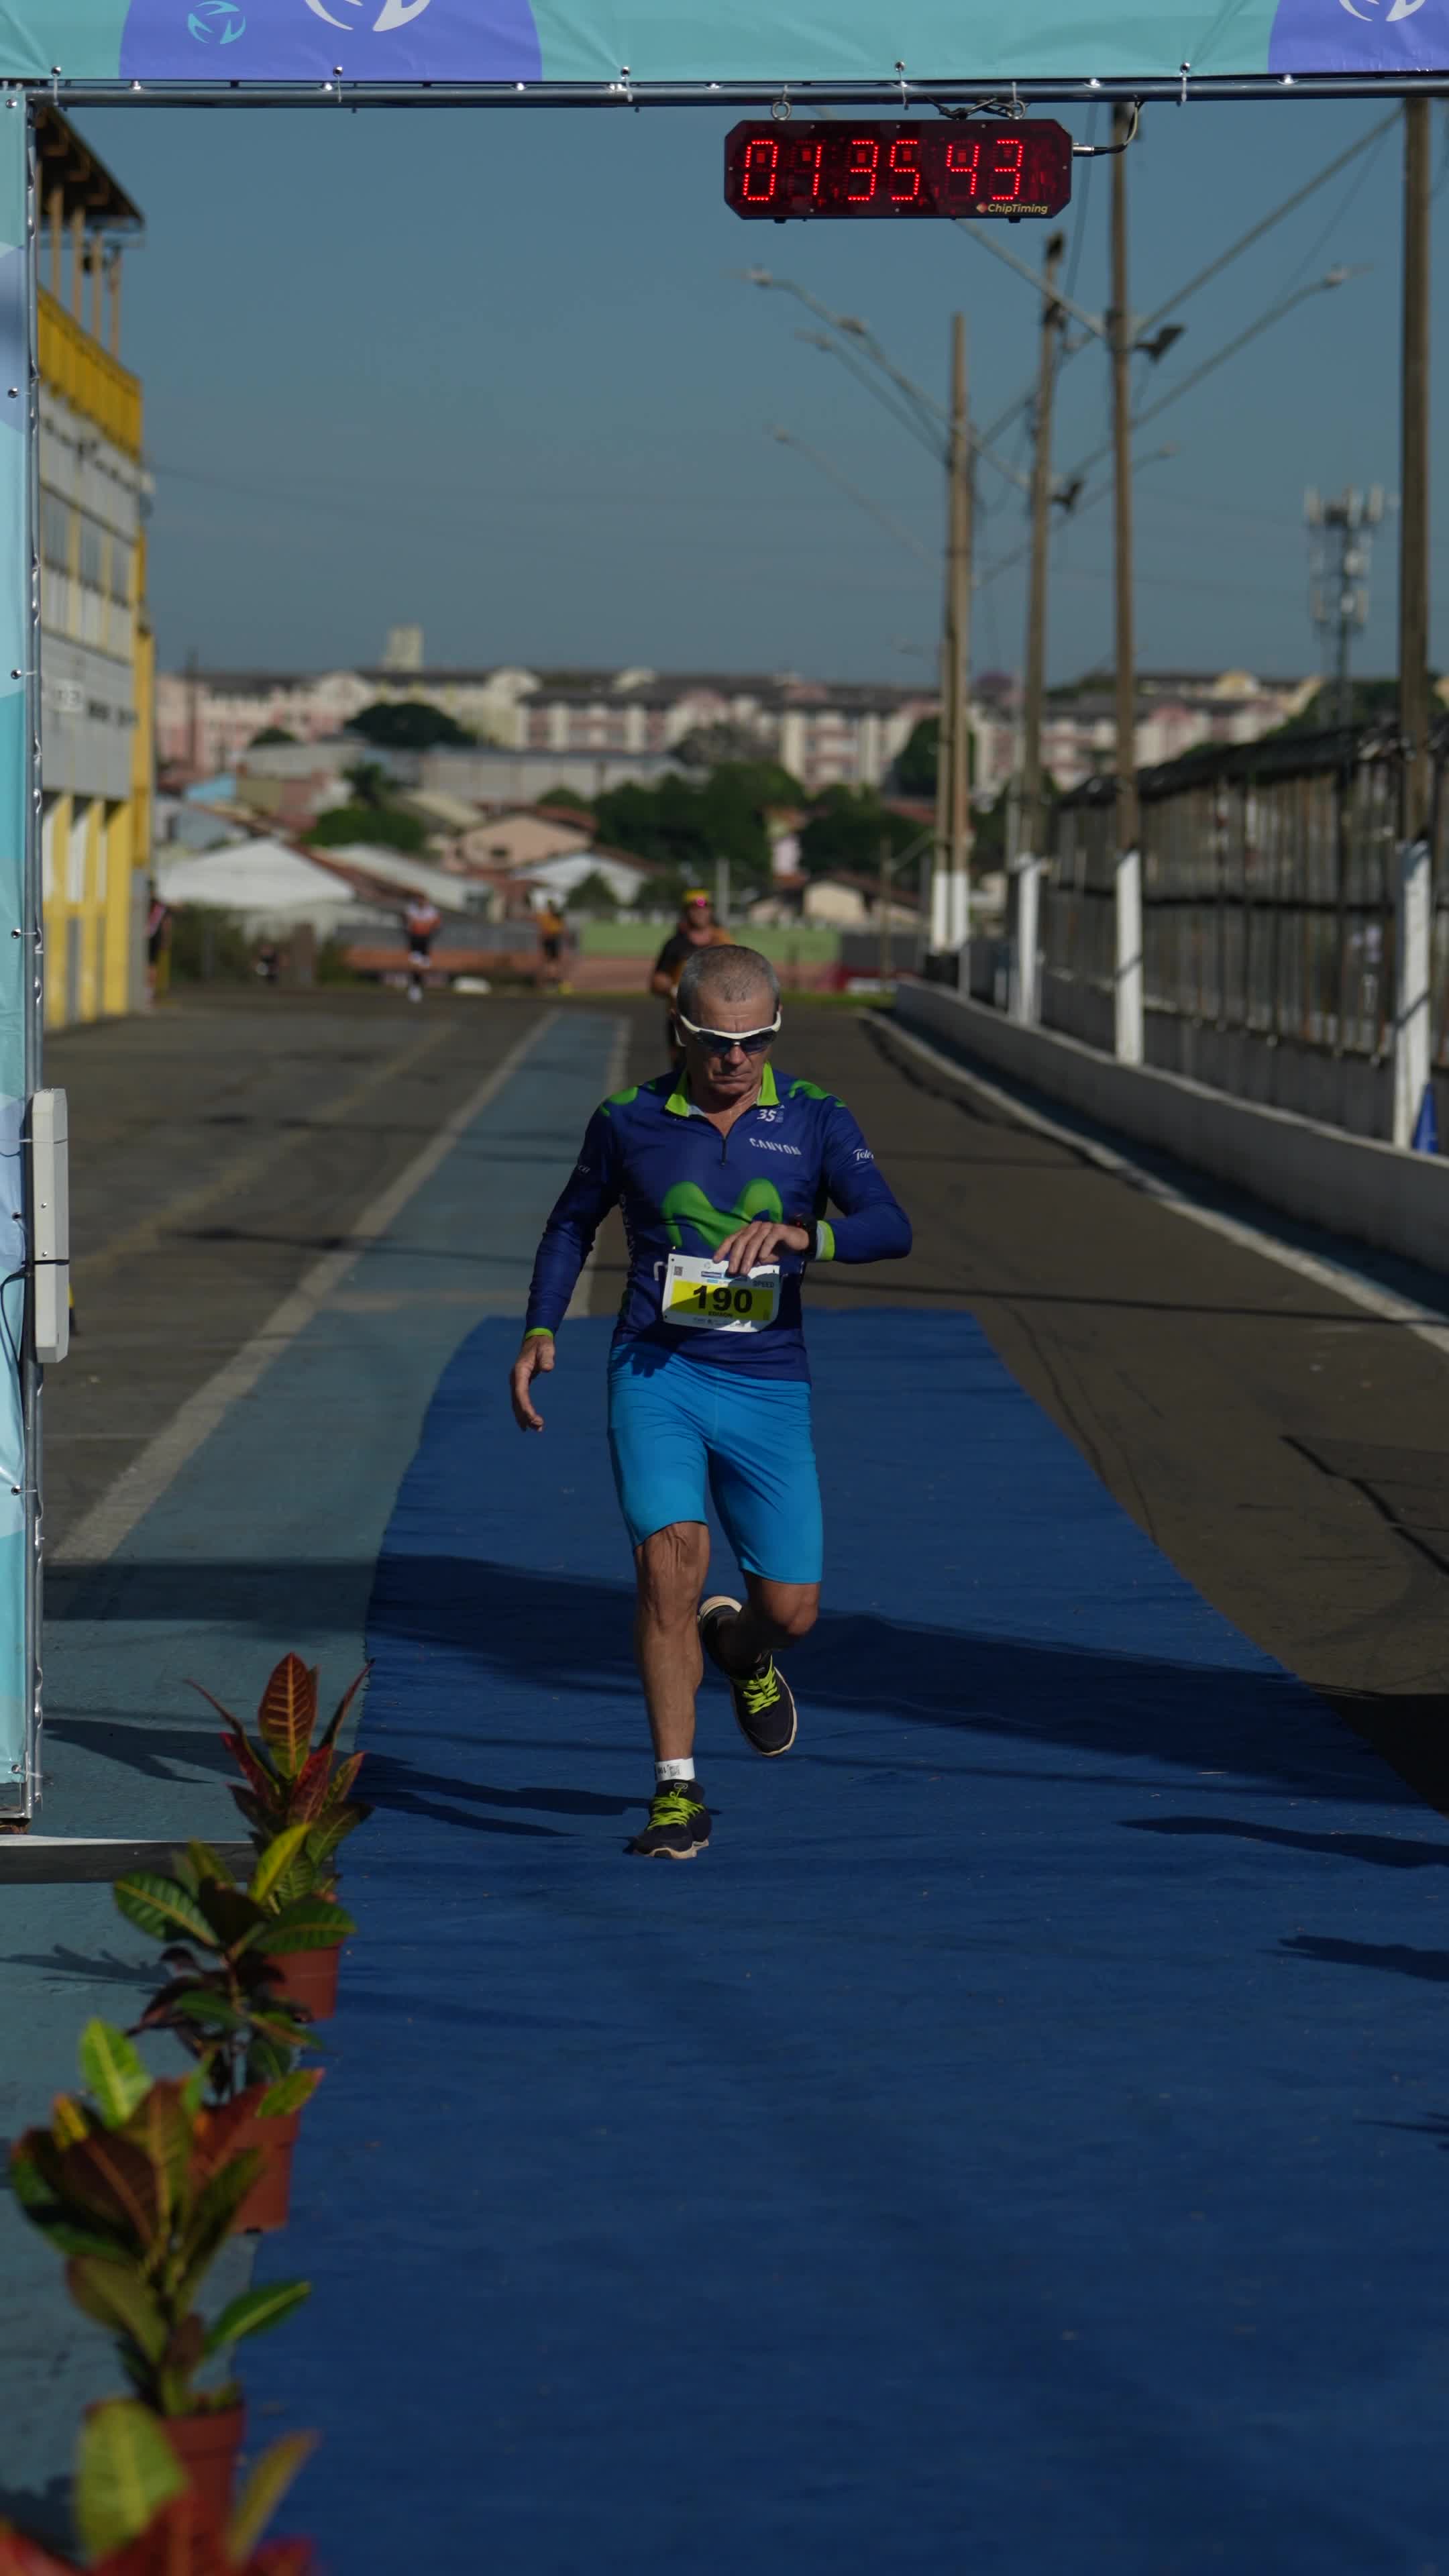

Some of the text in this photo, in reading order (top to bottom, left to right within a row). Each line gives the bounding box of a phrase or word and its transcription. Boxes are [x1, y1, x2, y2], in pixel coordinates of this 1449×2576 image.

[987, 202, 1048, 215] ChipTiming
[757, 1109, 777, 1122] 35
[749, 1138, 802, 1155] CANYON
[853, 1148, 875, 1161] Tele
[752, 1279, 775, 1289] SPEED
[693, 1285, 753, 1313] 190
